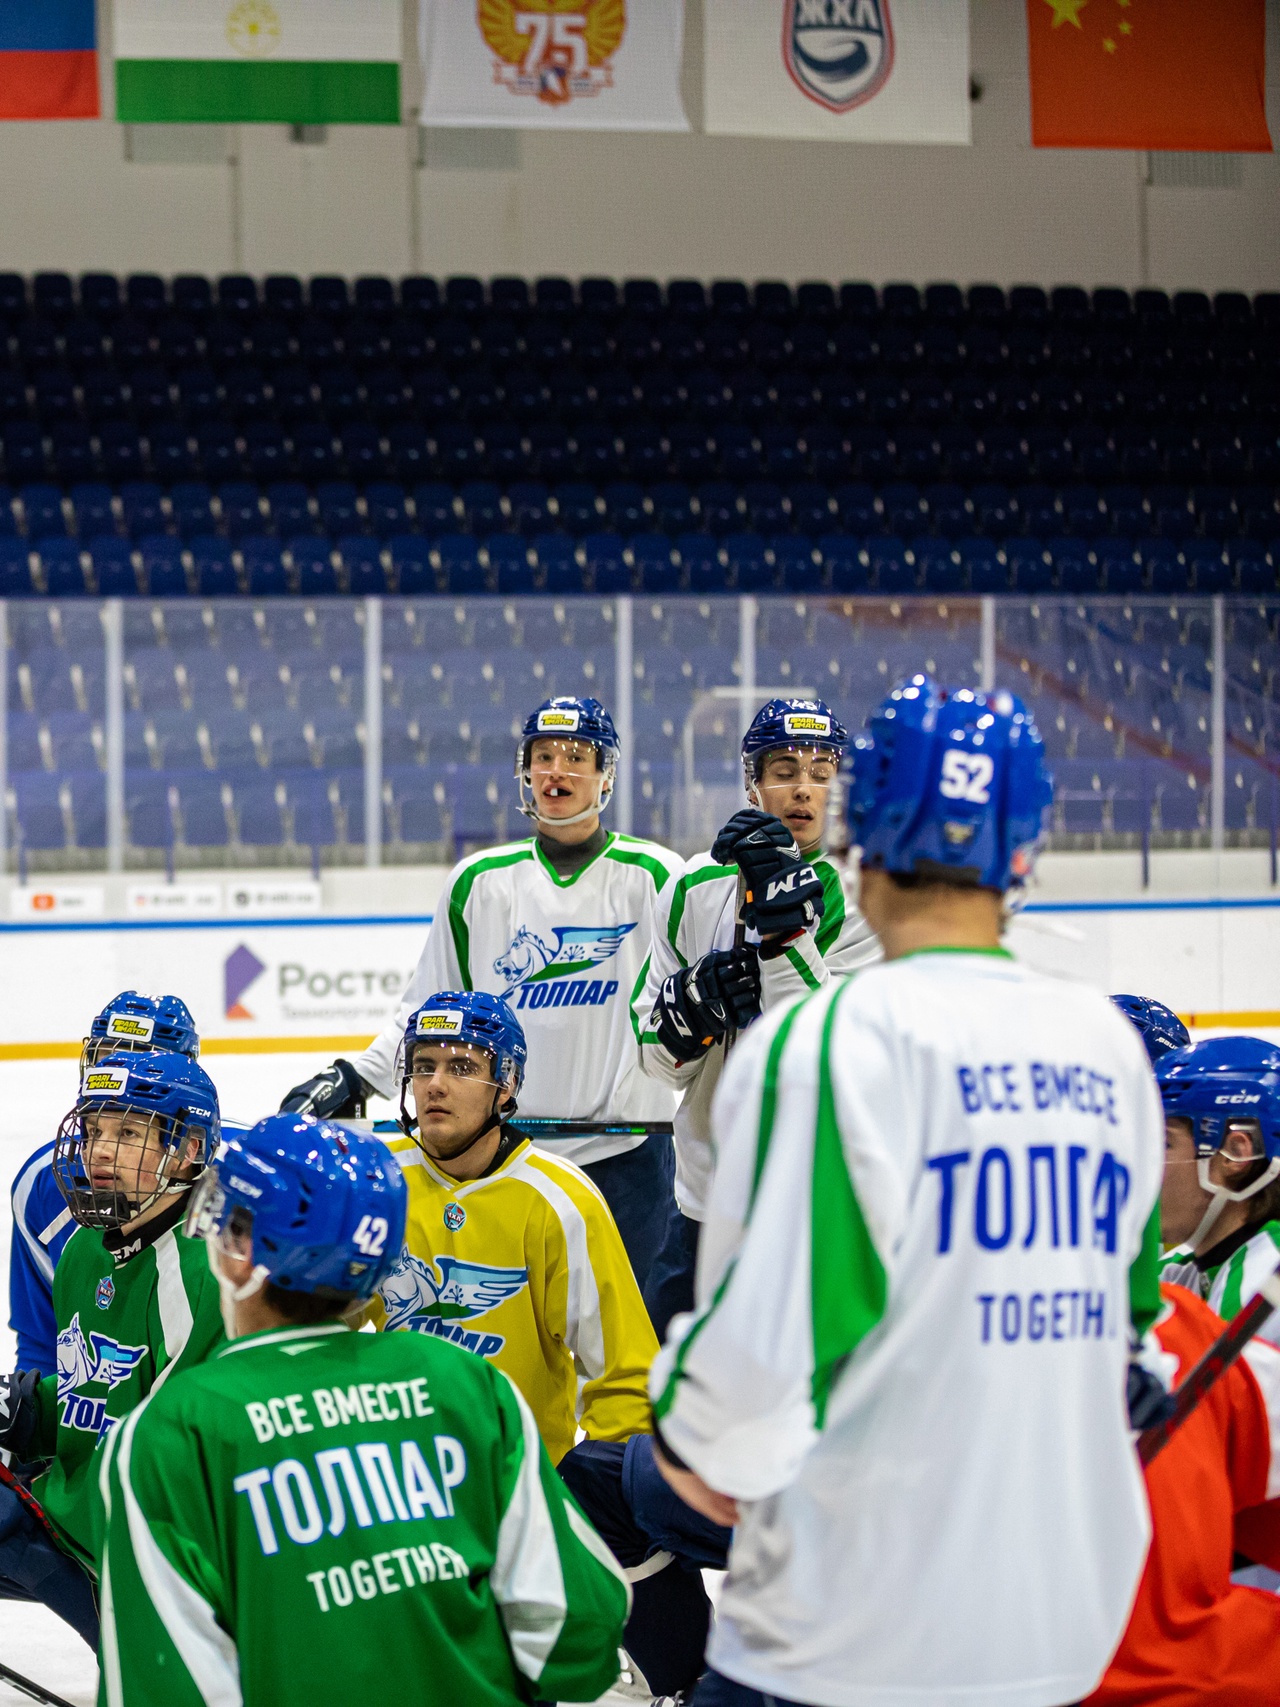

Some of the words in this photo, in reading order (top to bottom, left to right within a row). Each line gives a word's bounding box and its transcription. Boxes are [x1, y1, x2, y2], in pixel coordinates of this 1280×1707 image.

[515, 15, 587, 72] 75
[940, 749, 994, 804] 52
[278, 963, 415, 998] Росте
[516, 980, 619, 1010] ТОЛПАР
[114, 1019, 138, 1028] PARI
[116, 1025, 148, 1036] MATCH
[422, 1016, 446, 1024] PARI
[87, 1073, 111, 1082] PARI
[88, 1081, 121, 1089] MATCH
[957, 1063, 1022, 1115] ВСЕ
[188, 1105, 211, 1118] CCM
[1214, 1094, 1261, 1104] CCM
[353, 1215, 388, 1257] 42
[977, 1290, 1112, 1345] TOGETH
[245, 1394, 314, 1443] ВСЕ
[312, 1377, 435, 1428] ВМЕСТЕ
[232, 1434, 467, 1556] ТОЛПАР
